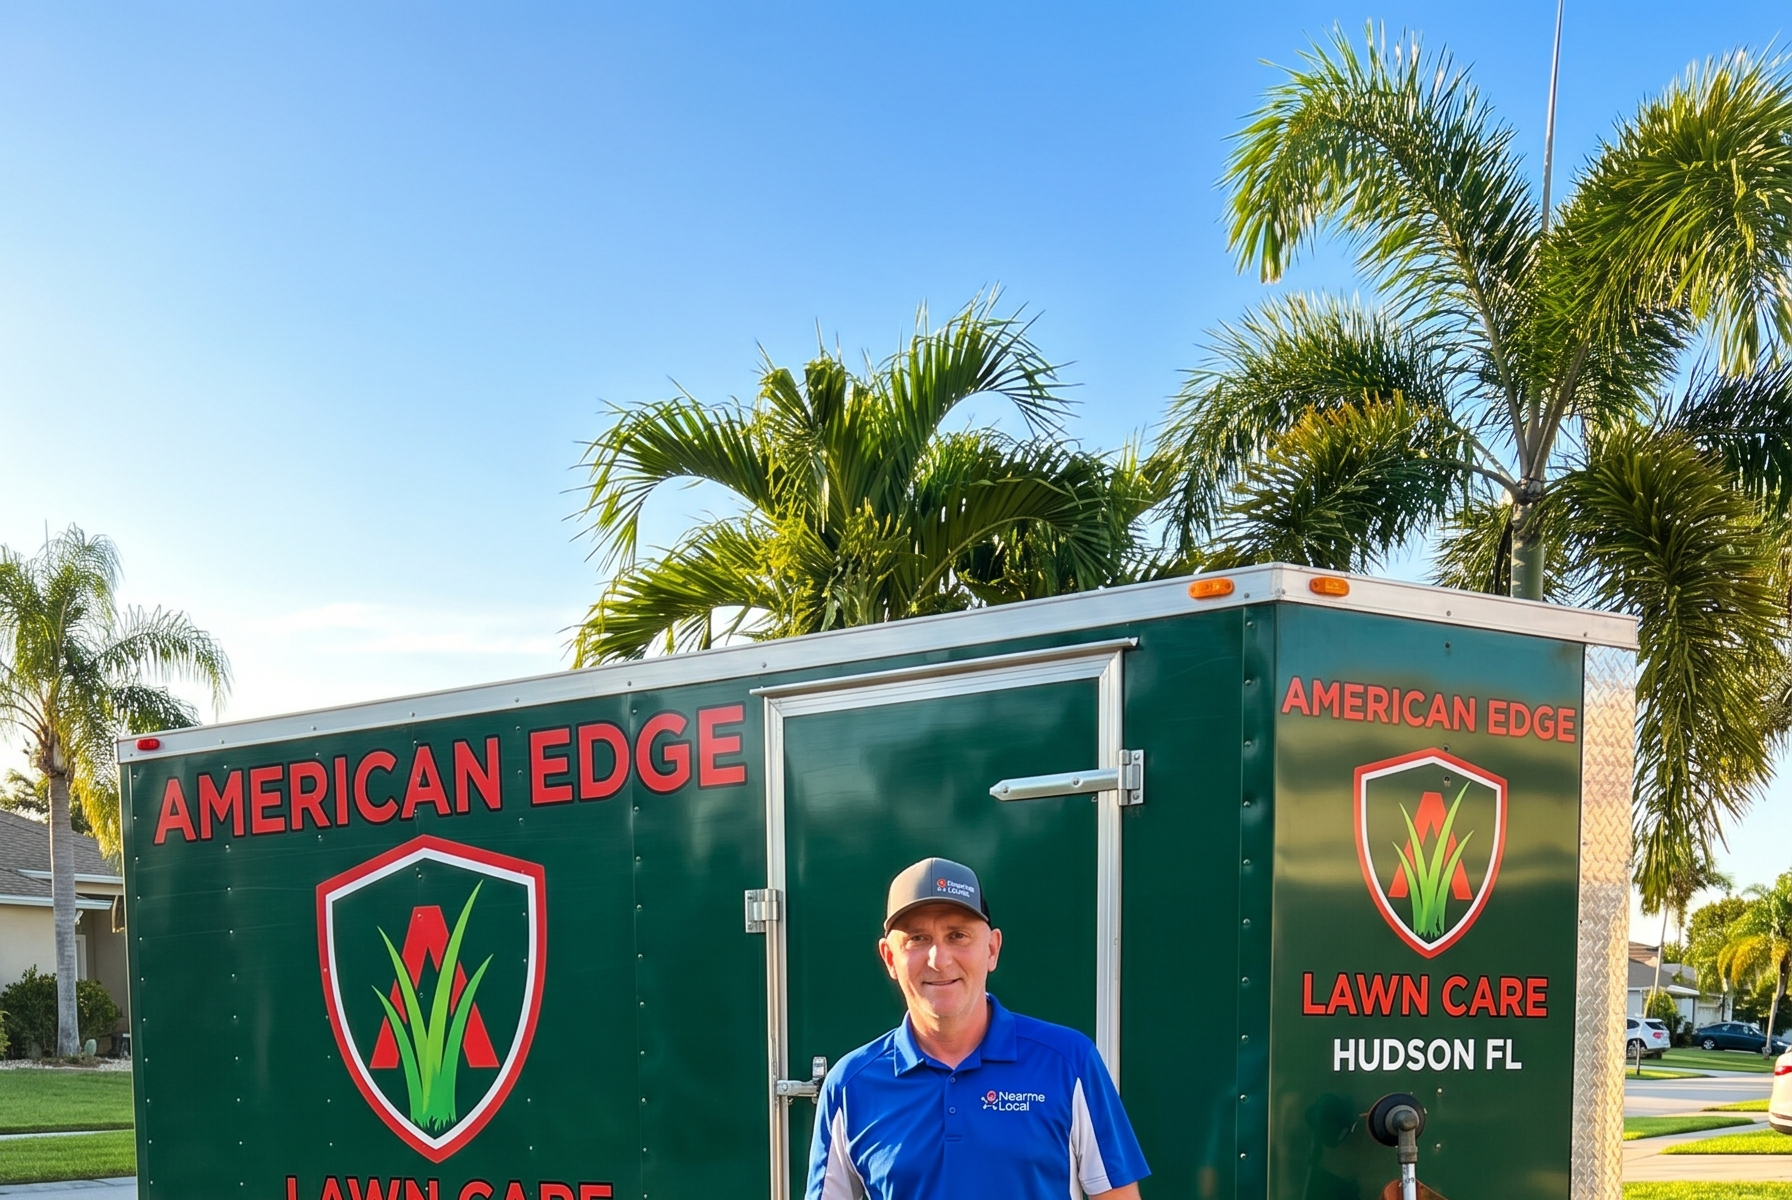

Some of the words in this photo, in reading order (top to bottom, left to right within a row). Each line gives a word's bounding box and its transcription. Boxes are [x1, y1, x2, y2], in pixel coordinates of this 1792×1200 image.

[1281, 677, 1477, 732] AMERICAN
[1486, 699, 1577, 744] EDGE
[153, 737, 502, 845] AMERICAN
[528, 704, 747, 805] EDGE
[1302, 972, 1430, 1017] LAWN
[1441, 975, 1549, 1018] CARE
[1332, 1037, 1476, 1073] HUDSON
[1485, 1038, 1523, 1071] FL
[998, 1091, 1045, 1102] Nearme
[998, 1101, 1030, 1111] Local
